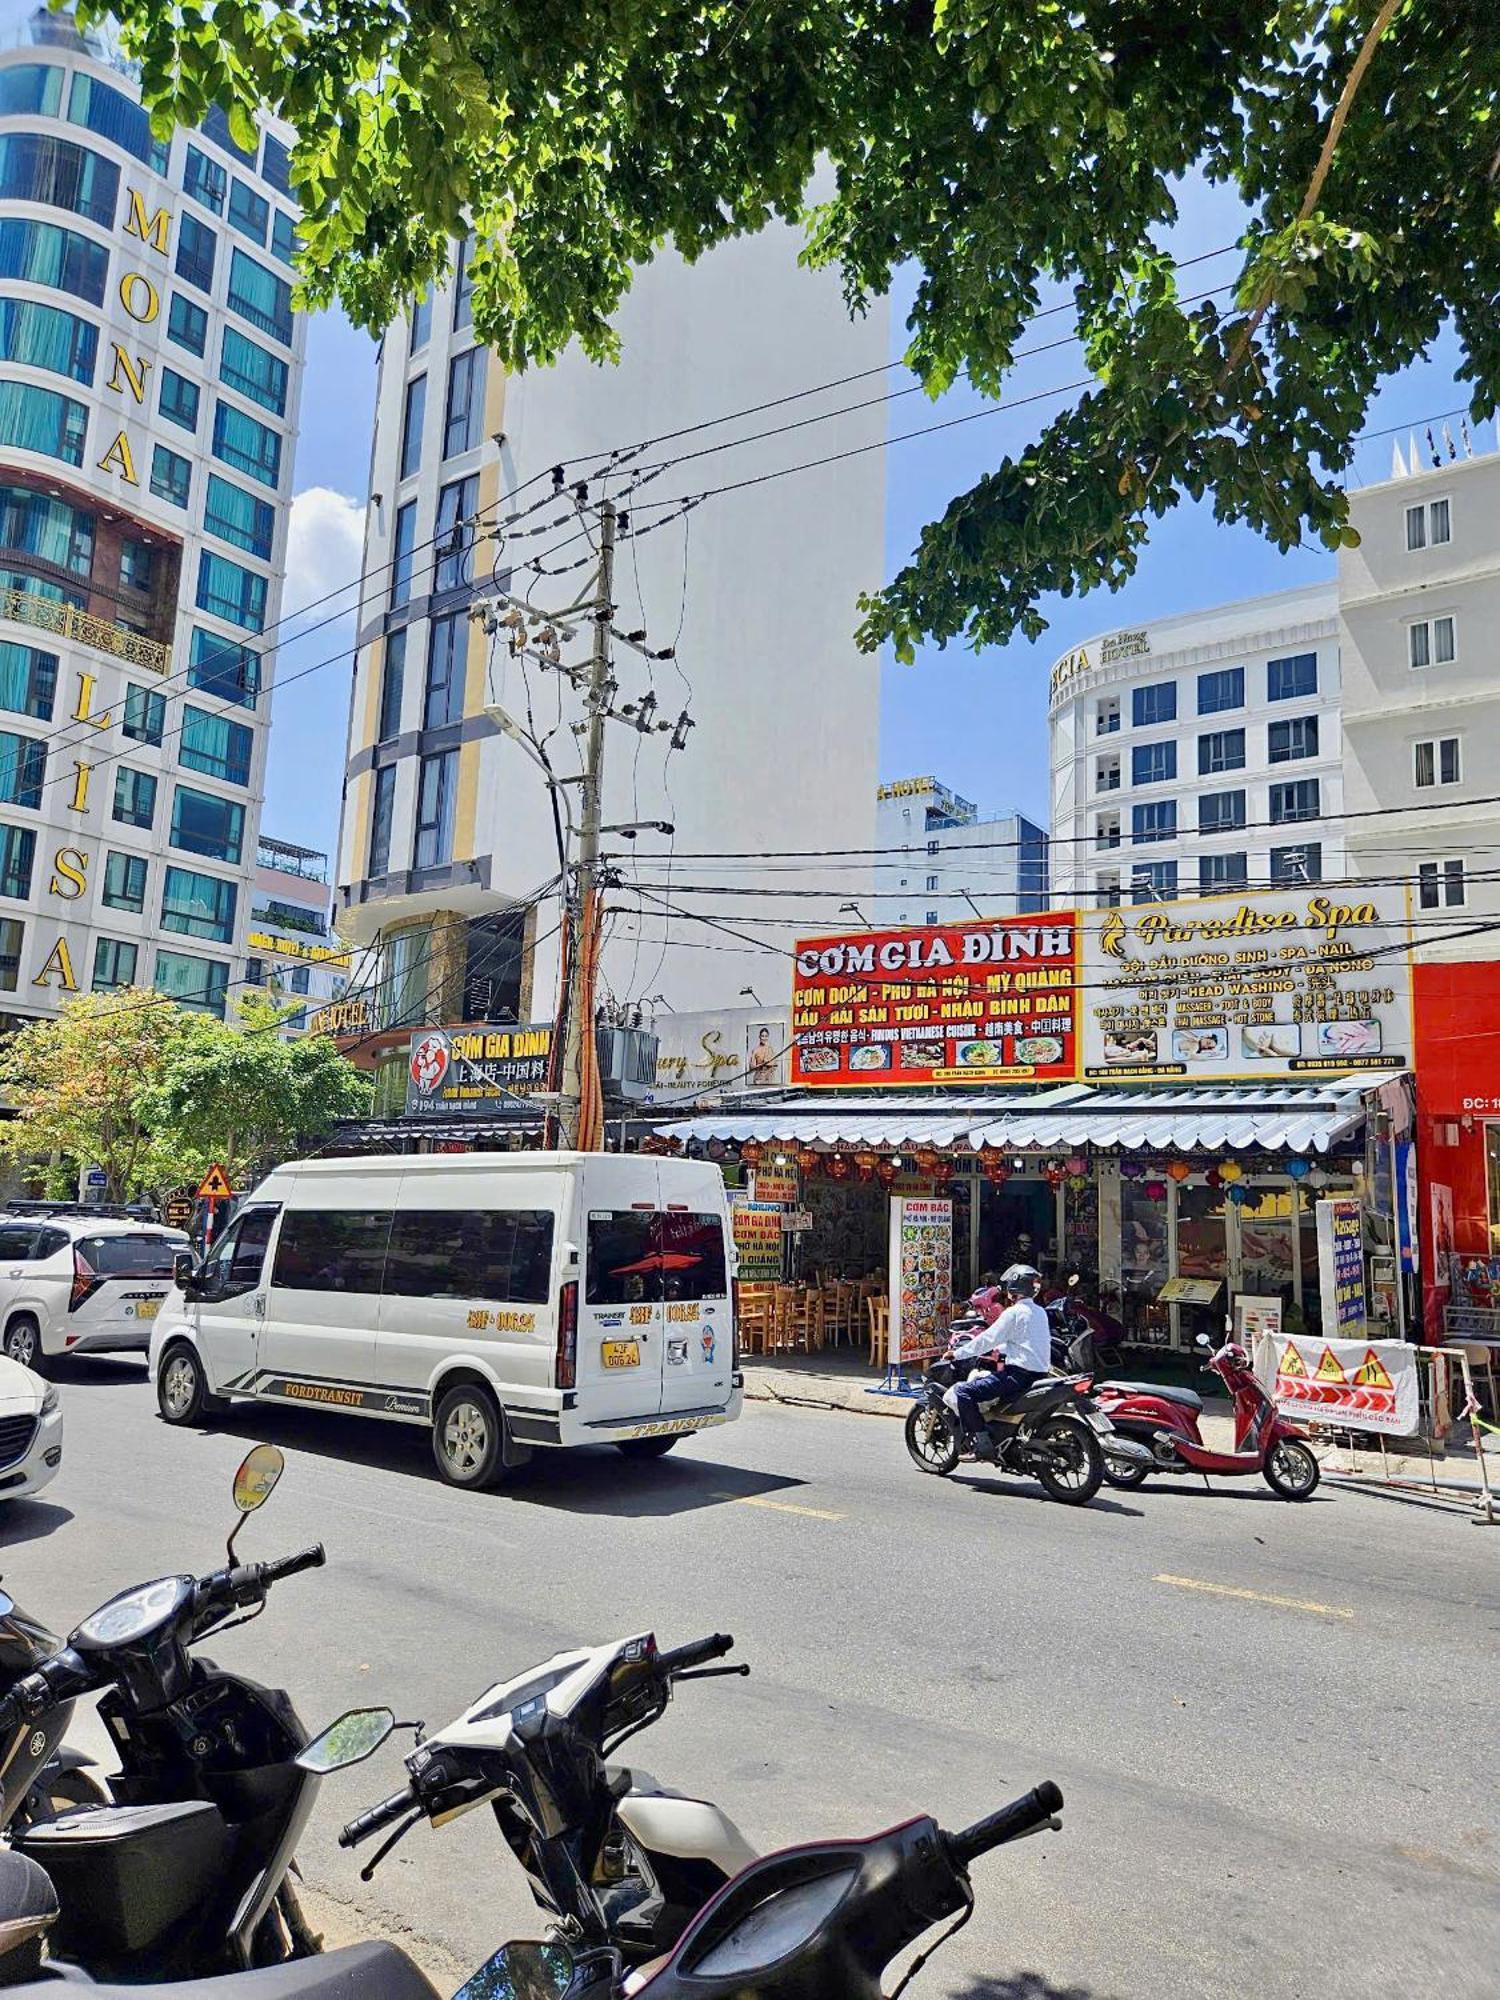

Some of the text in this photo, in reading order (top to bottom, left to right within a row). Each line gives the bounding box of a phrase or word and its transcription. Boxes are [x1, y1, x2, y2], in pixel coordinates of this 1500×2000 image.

[97, 186, 174, 487] MONA
[1101, 641, 1150, 664] HOTEL
[32, 672, 111, 991] LISA
[1136, 897, 1379, 945] Paradise Spa
[797, 924, 1072, 977] CƠM GIA ĐÌNH
[1235, 950, 1268, 964] SINH
[1280, 947, 1308, 960] SPA
[1319, 943, 1353, 957] NAIL
[1188, 981, 1295, 998] HEAD WASHING
[485, 1033, 510, 1059] GIA
[1462, 1097, 1489, 1109] ĐC:
[906, 1201, 928, 1212] CƠM
[285, 1382, 364, 1406] FORDTRANSIT
[632, 1415, 713, 1437] TRANSIT
